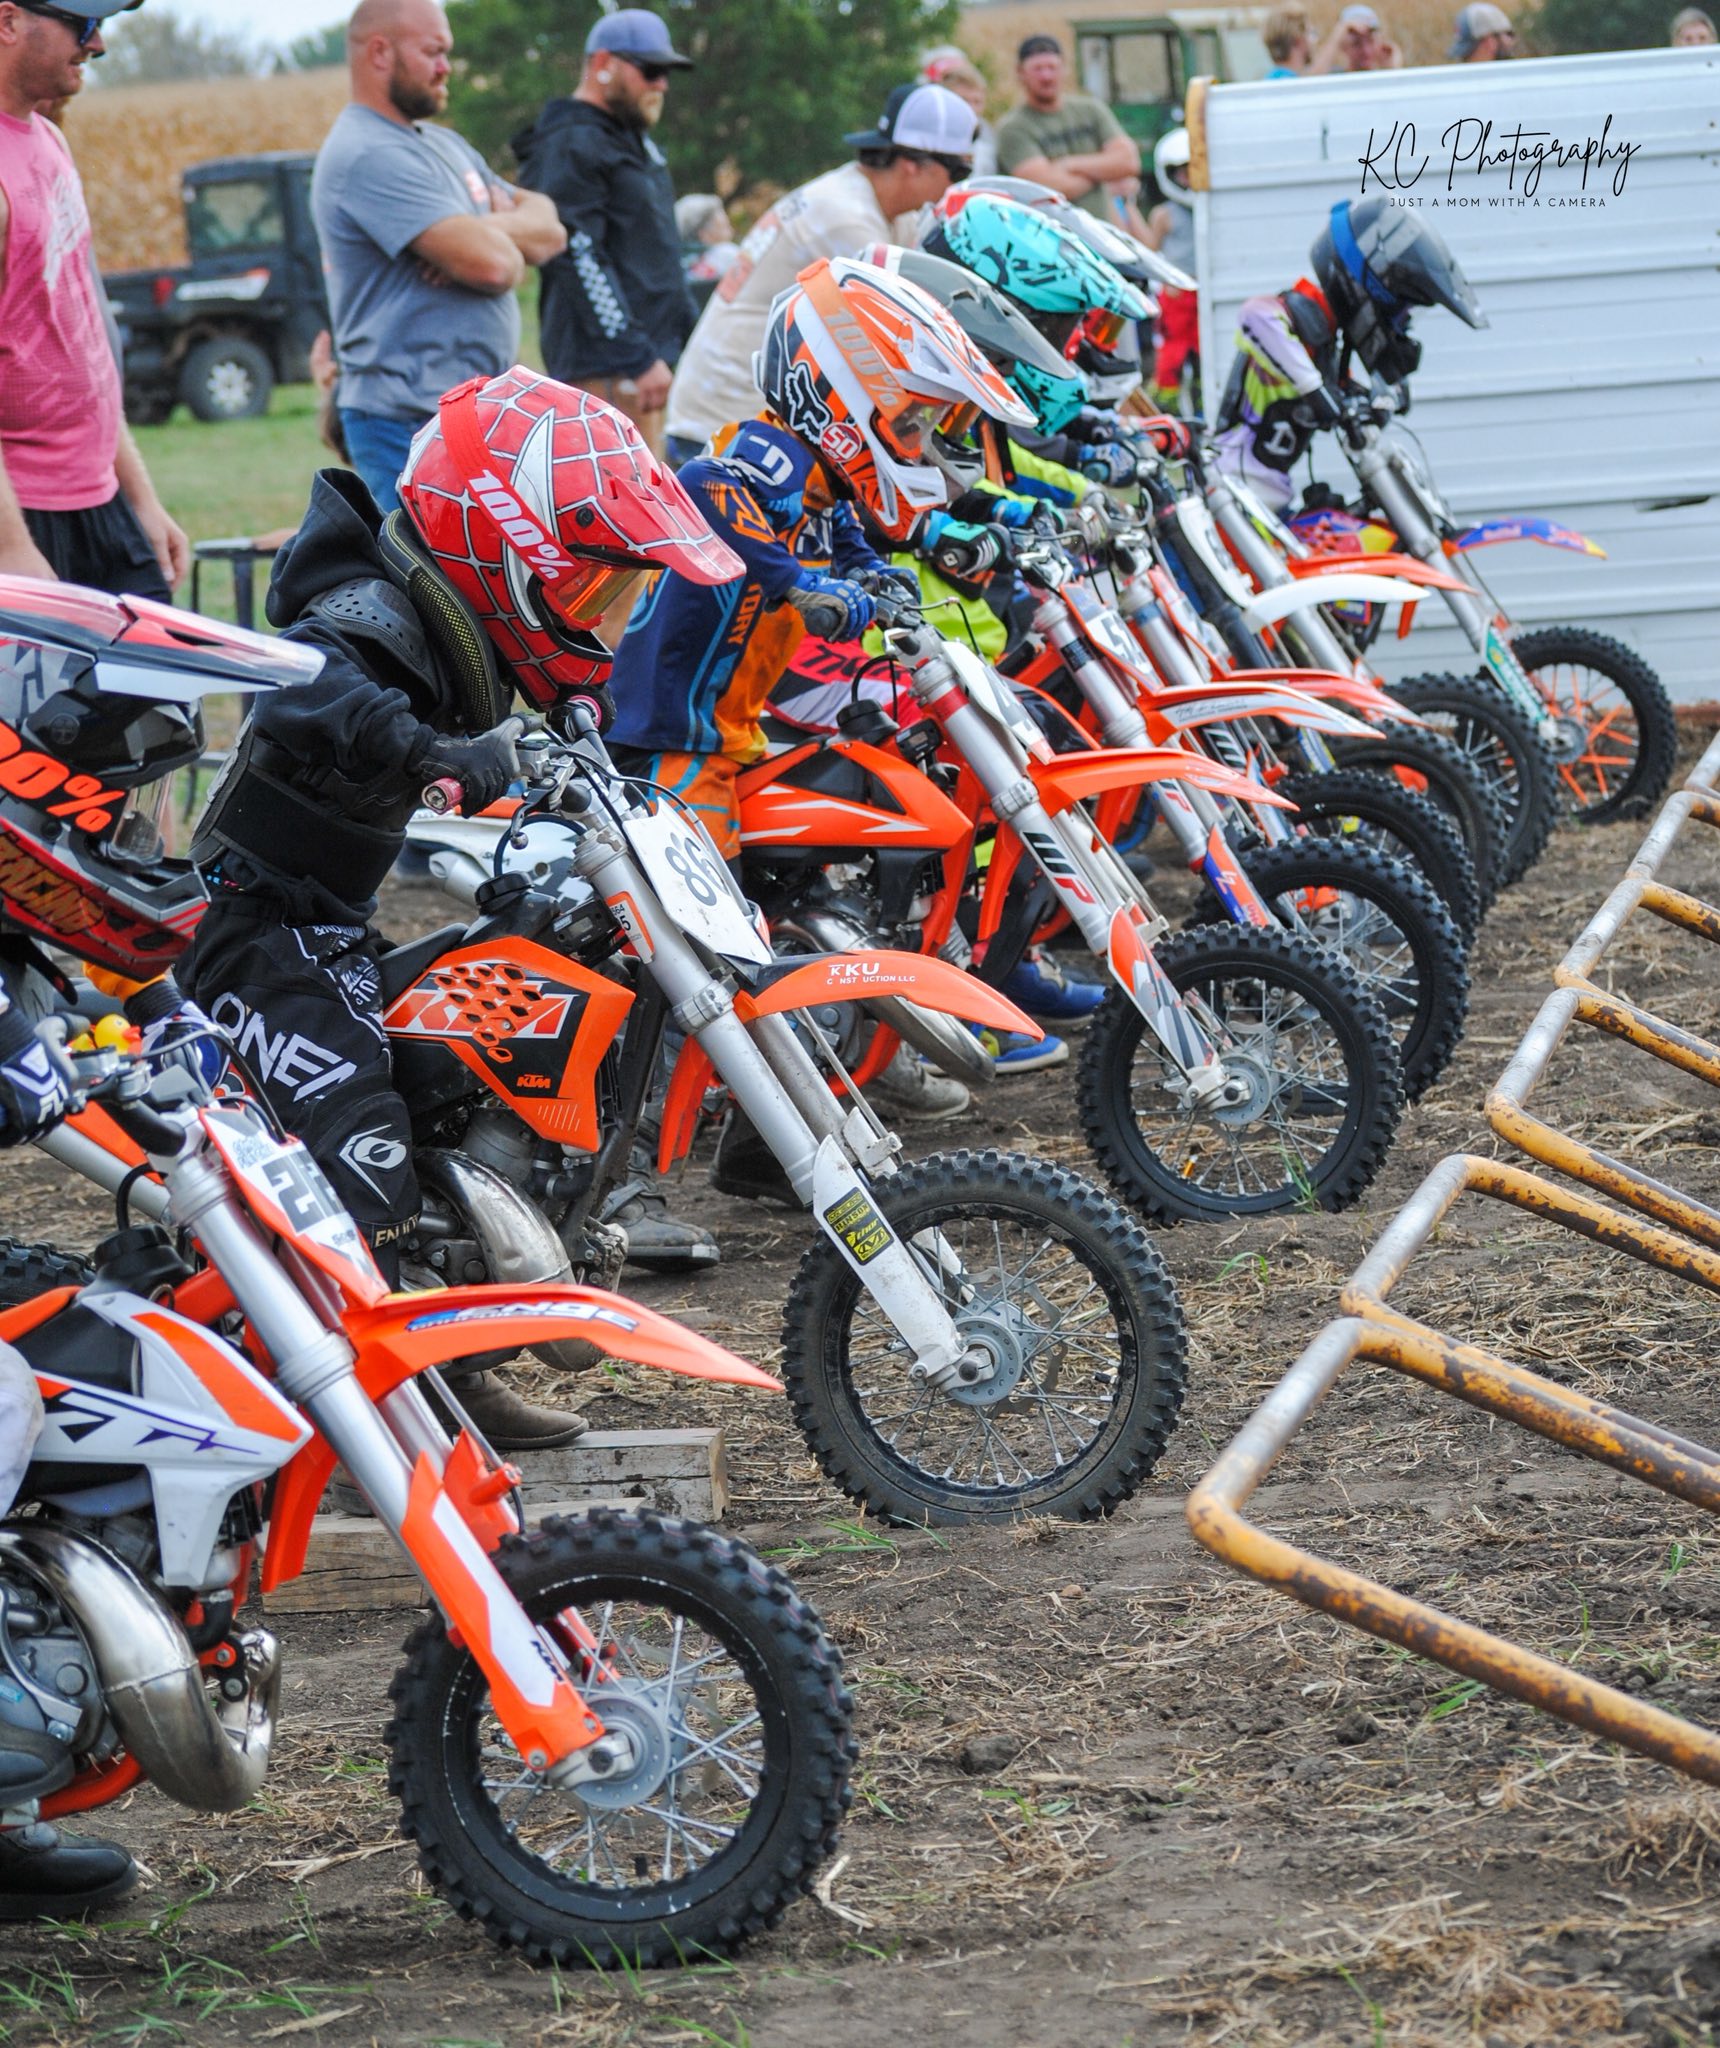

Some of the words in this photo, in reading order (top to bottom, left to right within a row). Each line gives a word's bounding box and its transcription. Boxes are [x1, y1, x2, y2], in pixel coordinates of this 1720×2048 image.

[823, 306, 904, 407] 100%
[823, 425, 859, 460] 50
[467, 468, 575, 579] 100%
[664, 835, 732, 907] 86
[898, 975, 916, 983] LLC
[516, 1073, 552, 1089] KTM
